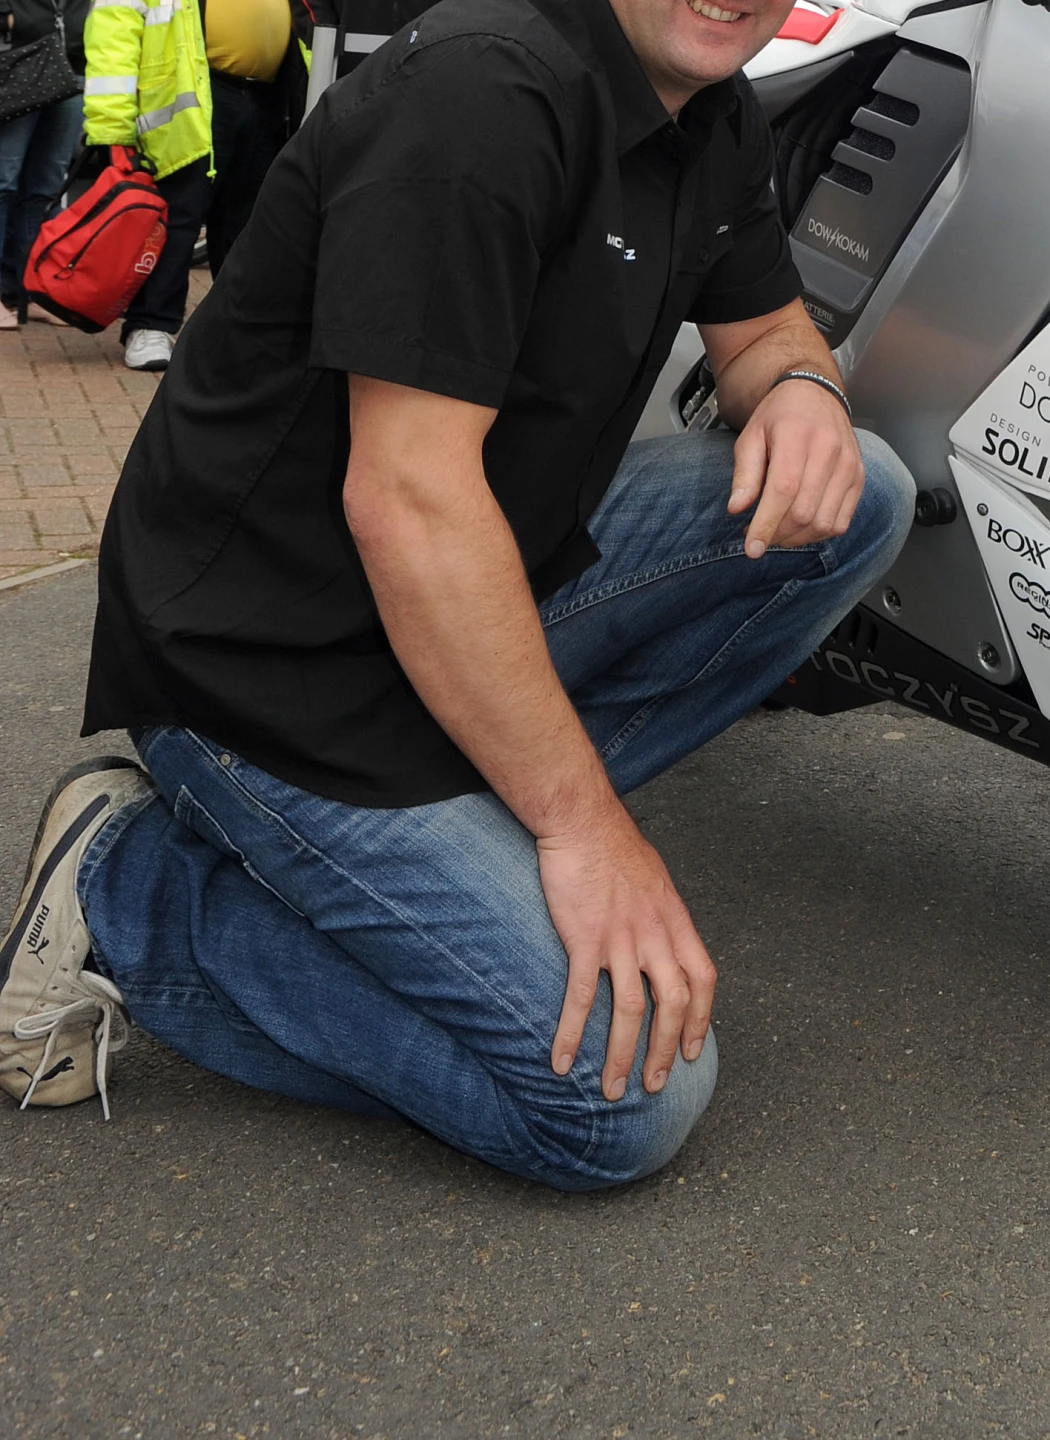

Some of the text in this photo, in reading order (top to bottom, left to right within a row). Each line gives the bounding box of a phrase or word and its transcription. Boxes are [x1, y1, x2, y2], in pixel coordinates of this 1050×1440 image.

[807, 218, 870, 262] DOW KOKAM
[989, 412, 1042, 447] DESIGN
[26, 904, 50, 948] PUMA
